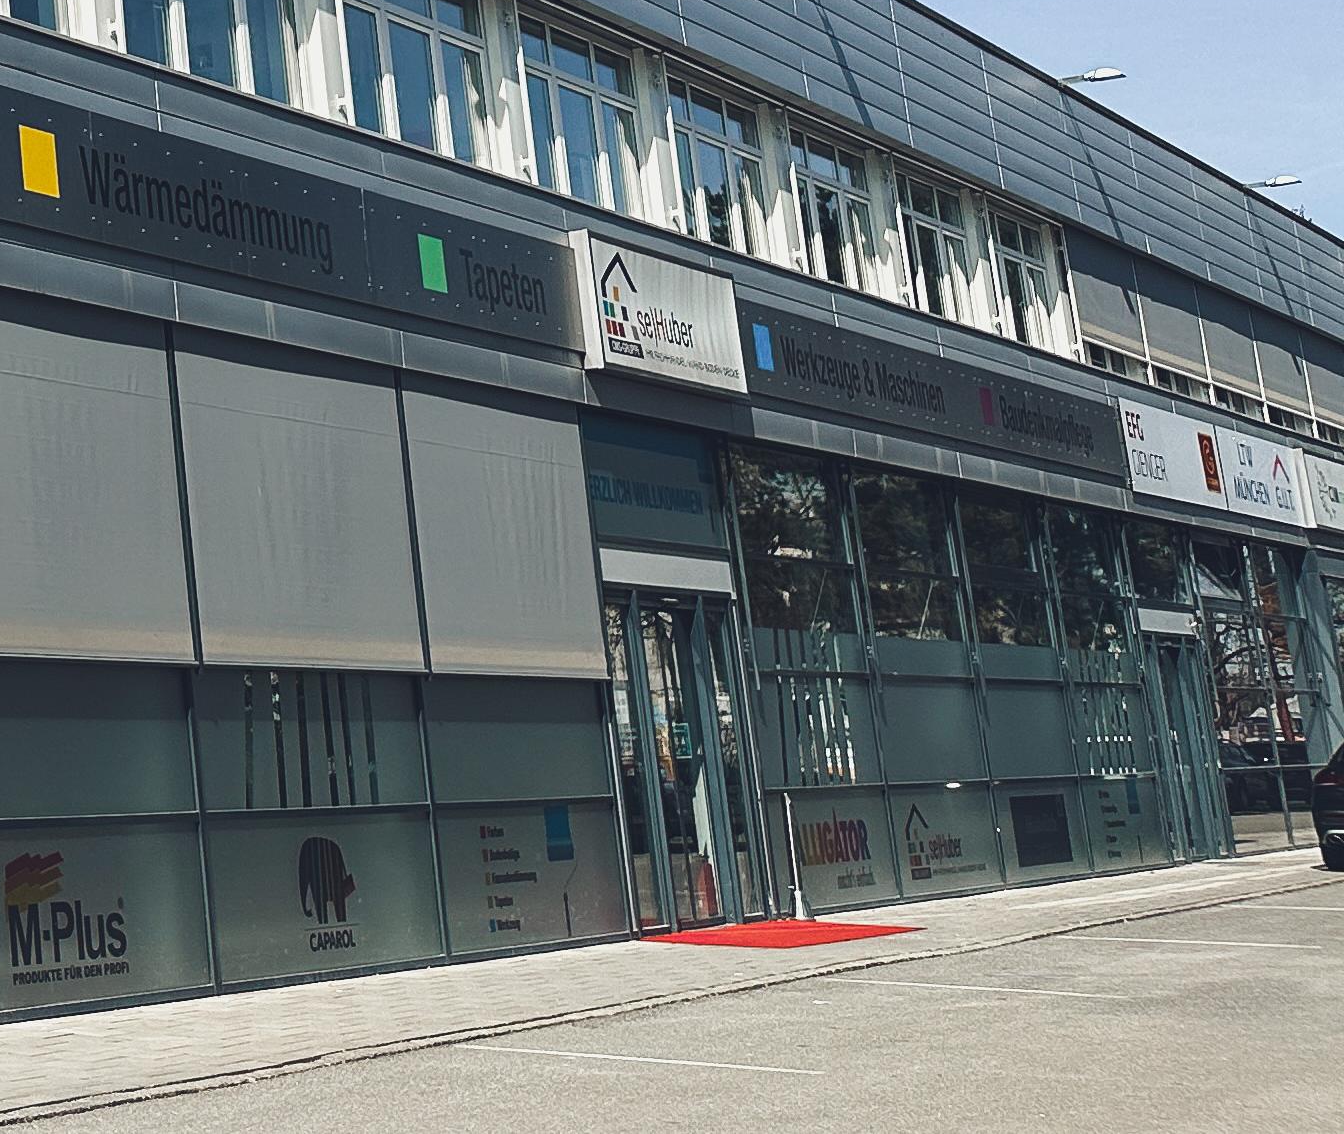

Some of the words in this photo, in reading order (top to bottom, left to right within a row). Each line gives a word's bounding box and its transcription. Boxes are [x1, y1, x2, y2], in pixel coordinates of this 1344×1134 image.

[78, 143, 334, 275] Wärmedämmung
[459, 247, 548, 316] Tapeten
[779, 335, 862, 401] Werkzeuge
[863, 362, 876, 398] &
[877, 363, 947, 415] Maschinen
[1125, 410, 1145, 441] EFG
[1131, 449, 1169, 482] GIENGER
[589, 473, 633, 505] ERZLICH
[309, 928, 357, 953] CAPAROL
[12, 969, 63, 987] PRODUKTE
[64, 965, 84, 981] FÜR
[84, 964, 103, 979] DEN
[104, 962, 130, 977] PROFI
